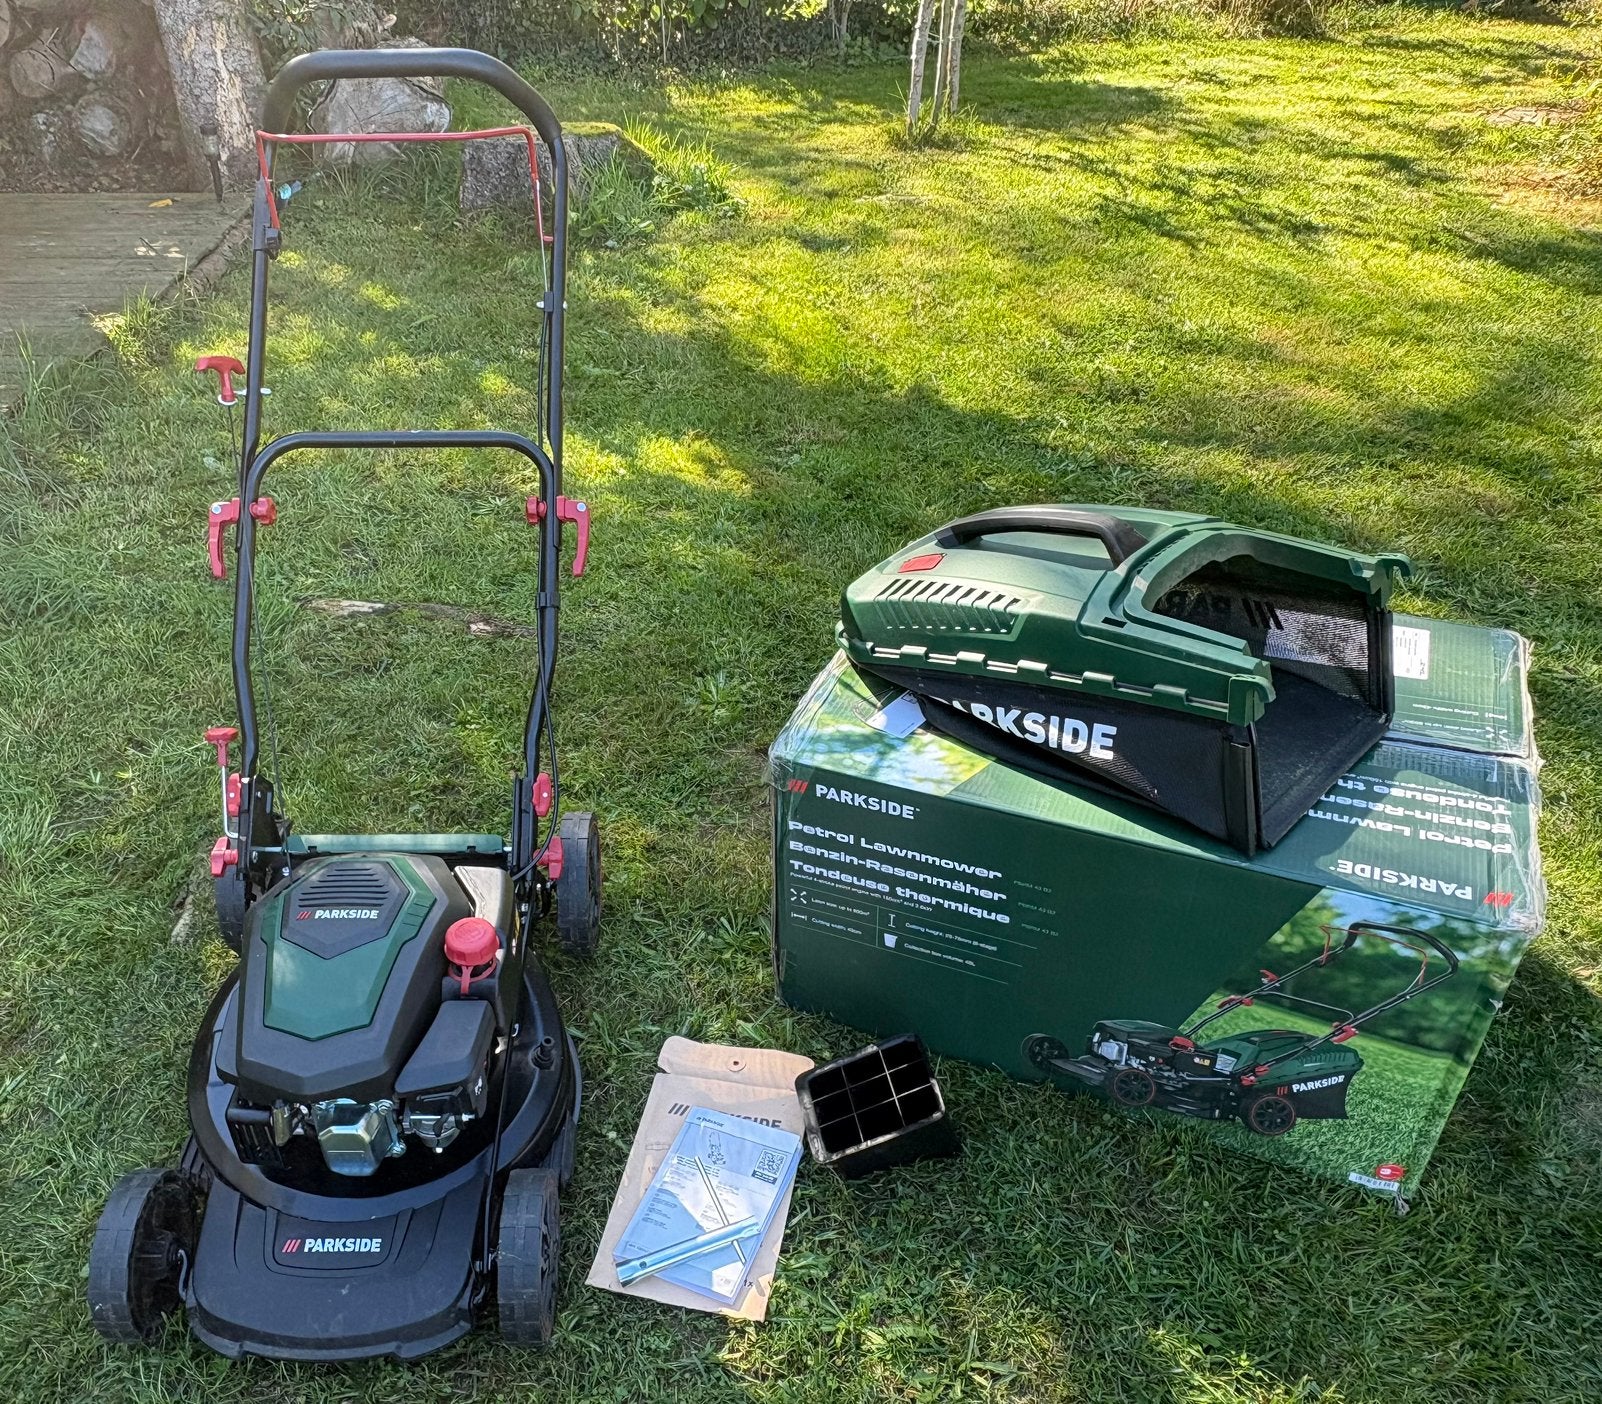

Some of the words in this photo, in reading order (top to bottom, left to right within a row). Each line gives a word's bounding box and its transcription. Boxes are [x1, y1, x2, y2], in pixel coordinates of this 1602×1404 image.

[930, 696, 1117, 760] RKSIDE
[815, 783, 915, 820] PARKSIDE
[1319, 794, 1512, 834] Benzin-Rasen
[1374, 783, 1511, 815] Tondeuse
[1307, 808, 1411, 836] Lawnm
[788, 820, 855, 845] Petrol
[861, 837, 1003, 881] Lawnmower
[1419, 829, 1512, 854] Petrol
[789, 840, 1008, 901] Benzin-Rasenmäher
[1336, 859, 1473, 900] PARKSIDE
[789, 859, 891, 893] Tondeuse
[895, 885, 1011, 925] thermique
[314, 909, 380, 919] PARKSIDE
[1291, 1074, 1345, 1093] PARKSIDE
[303, 1237, 382, 1253] PARKSIDE
